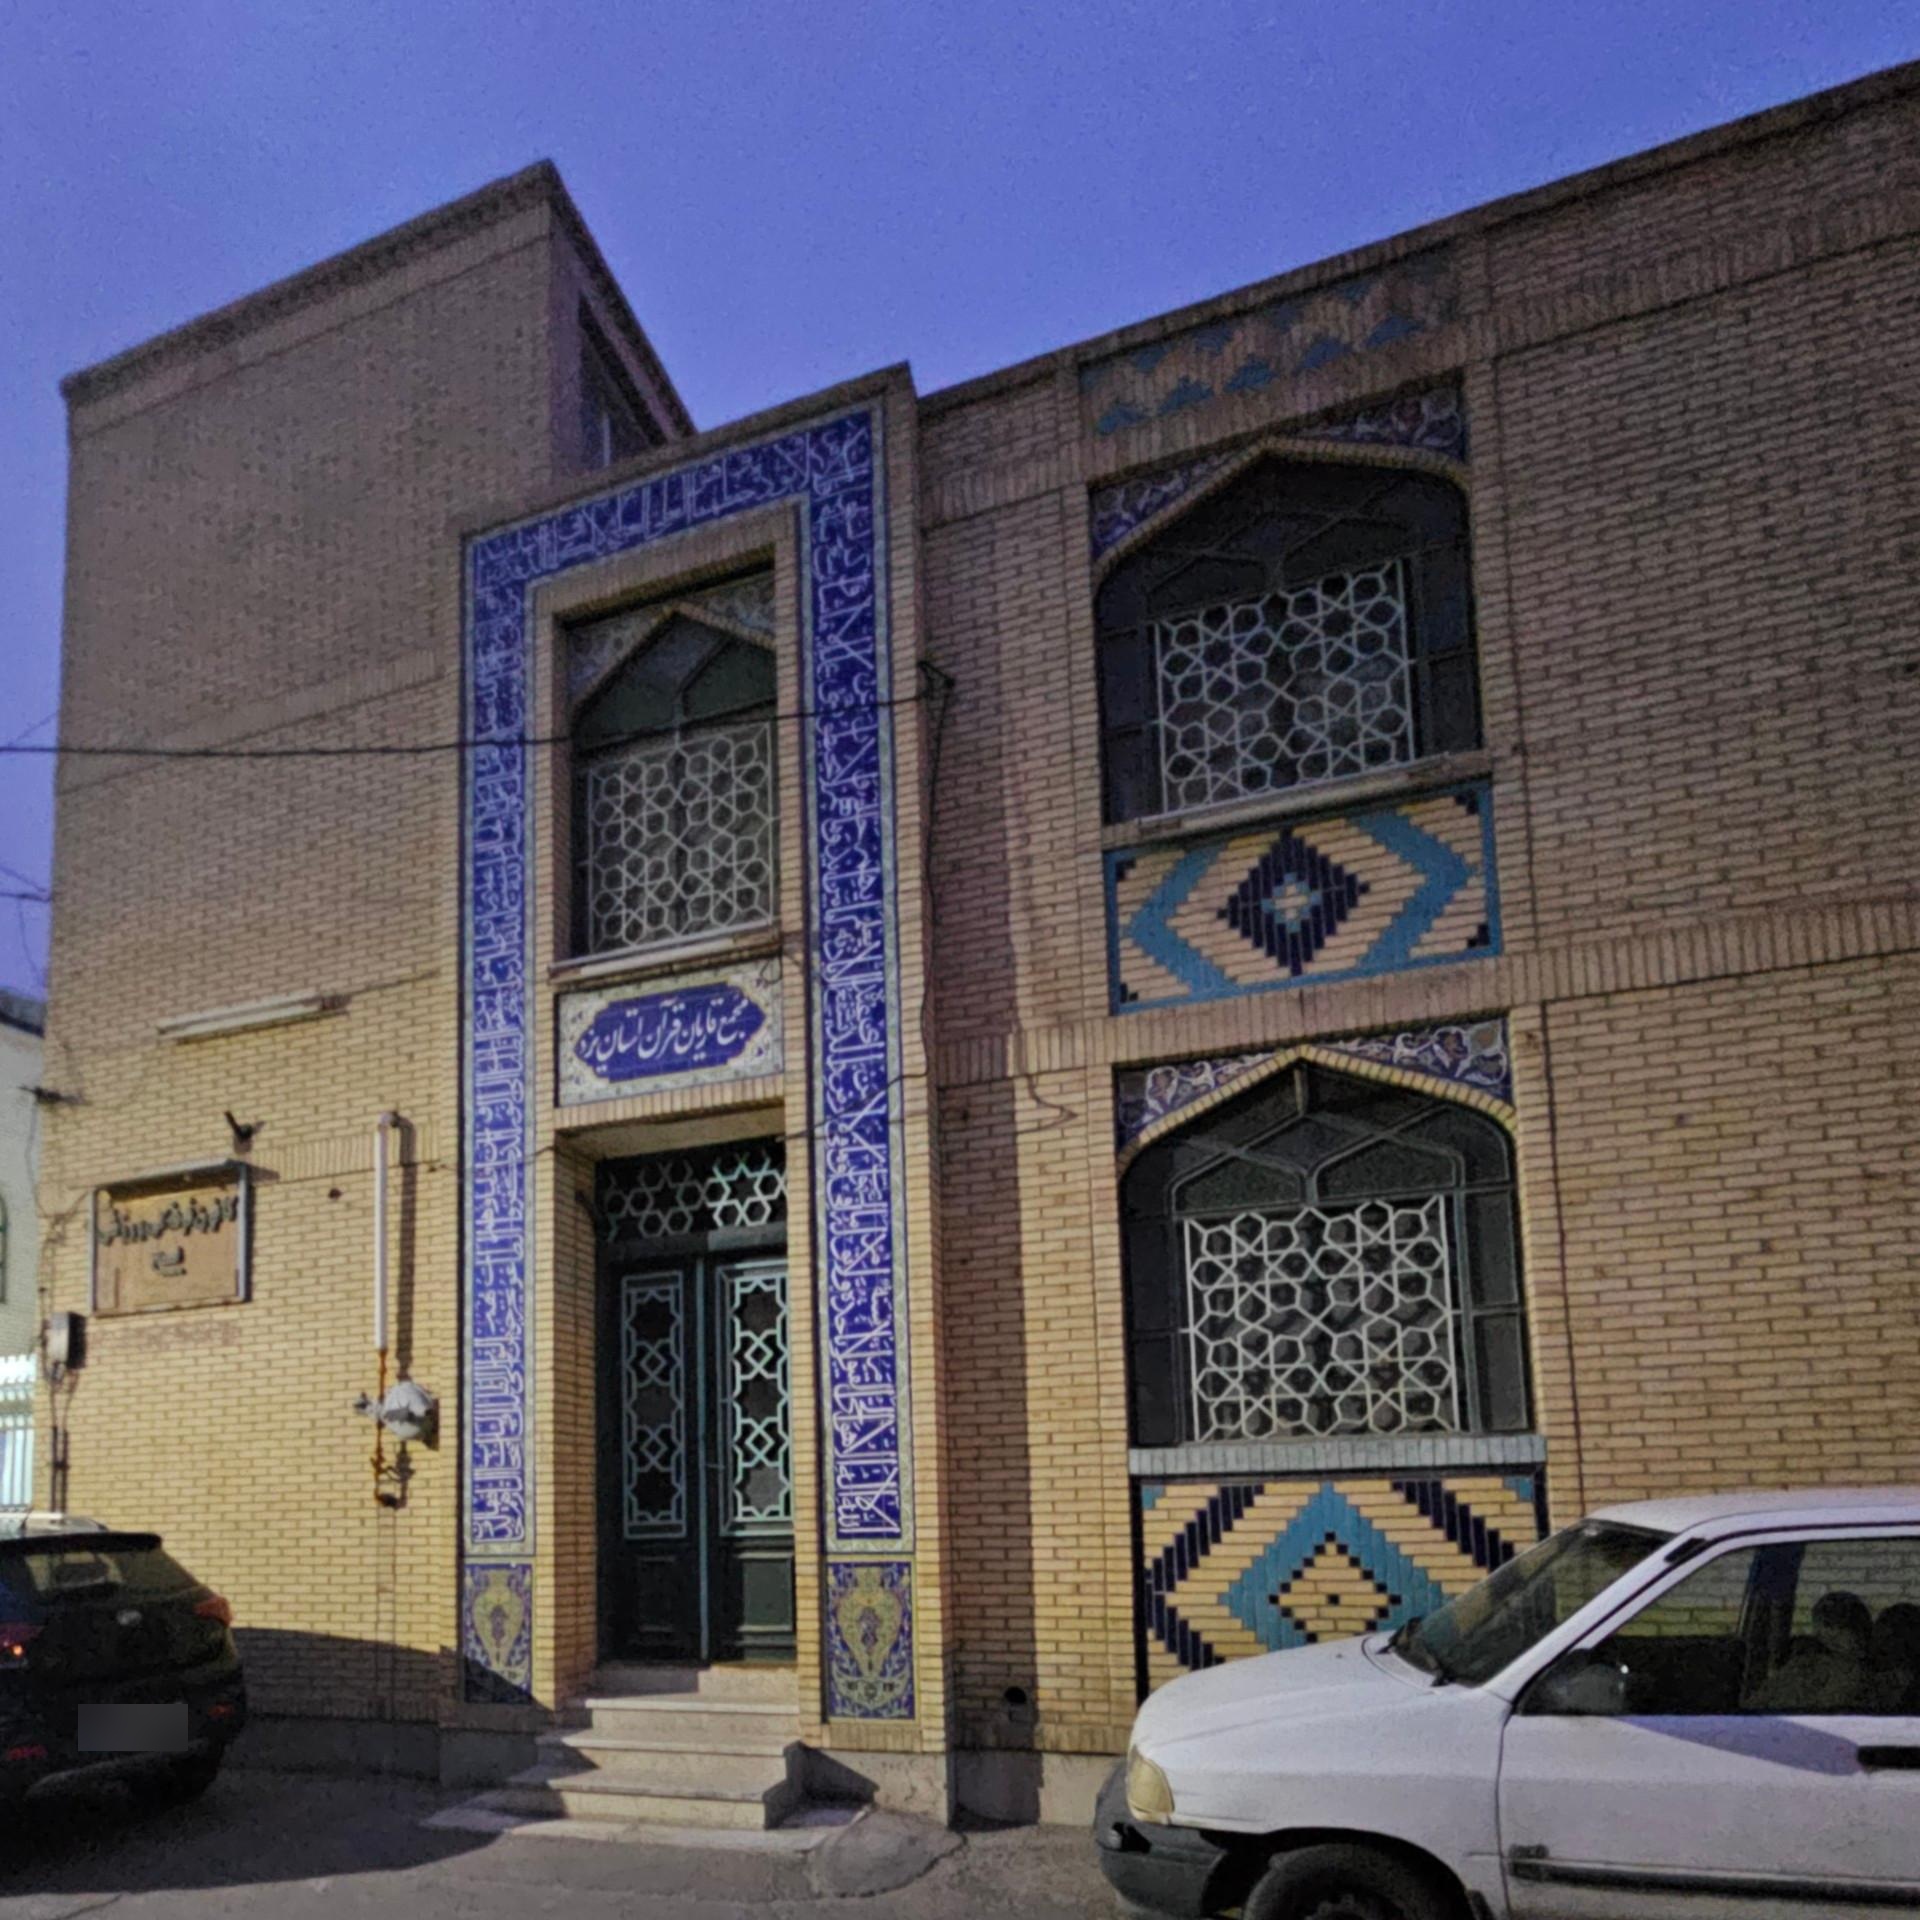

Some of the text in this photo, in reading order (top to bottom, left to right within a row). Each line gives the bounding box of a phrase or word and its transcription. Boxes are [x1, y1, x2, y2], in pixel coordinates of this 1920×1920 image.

[579, 993, 749, 1072] مجمع قاریان قرآن استان یزد
